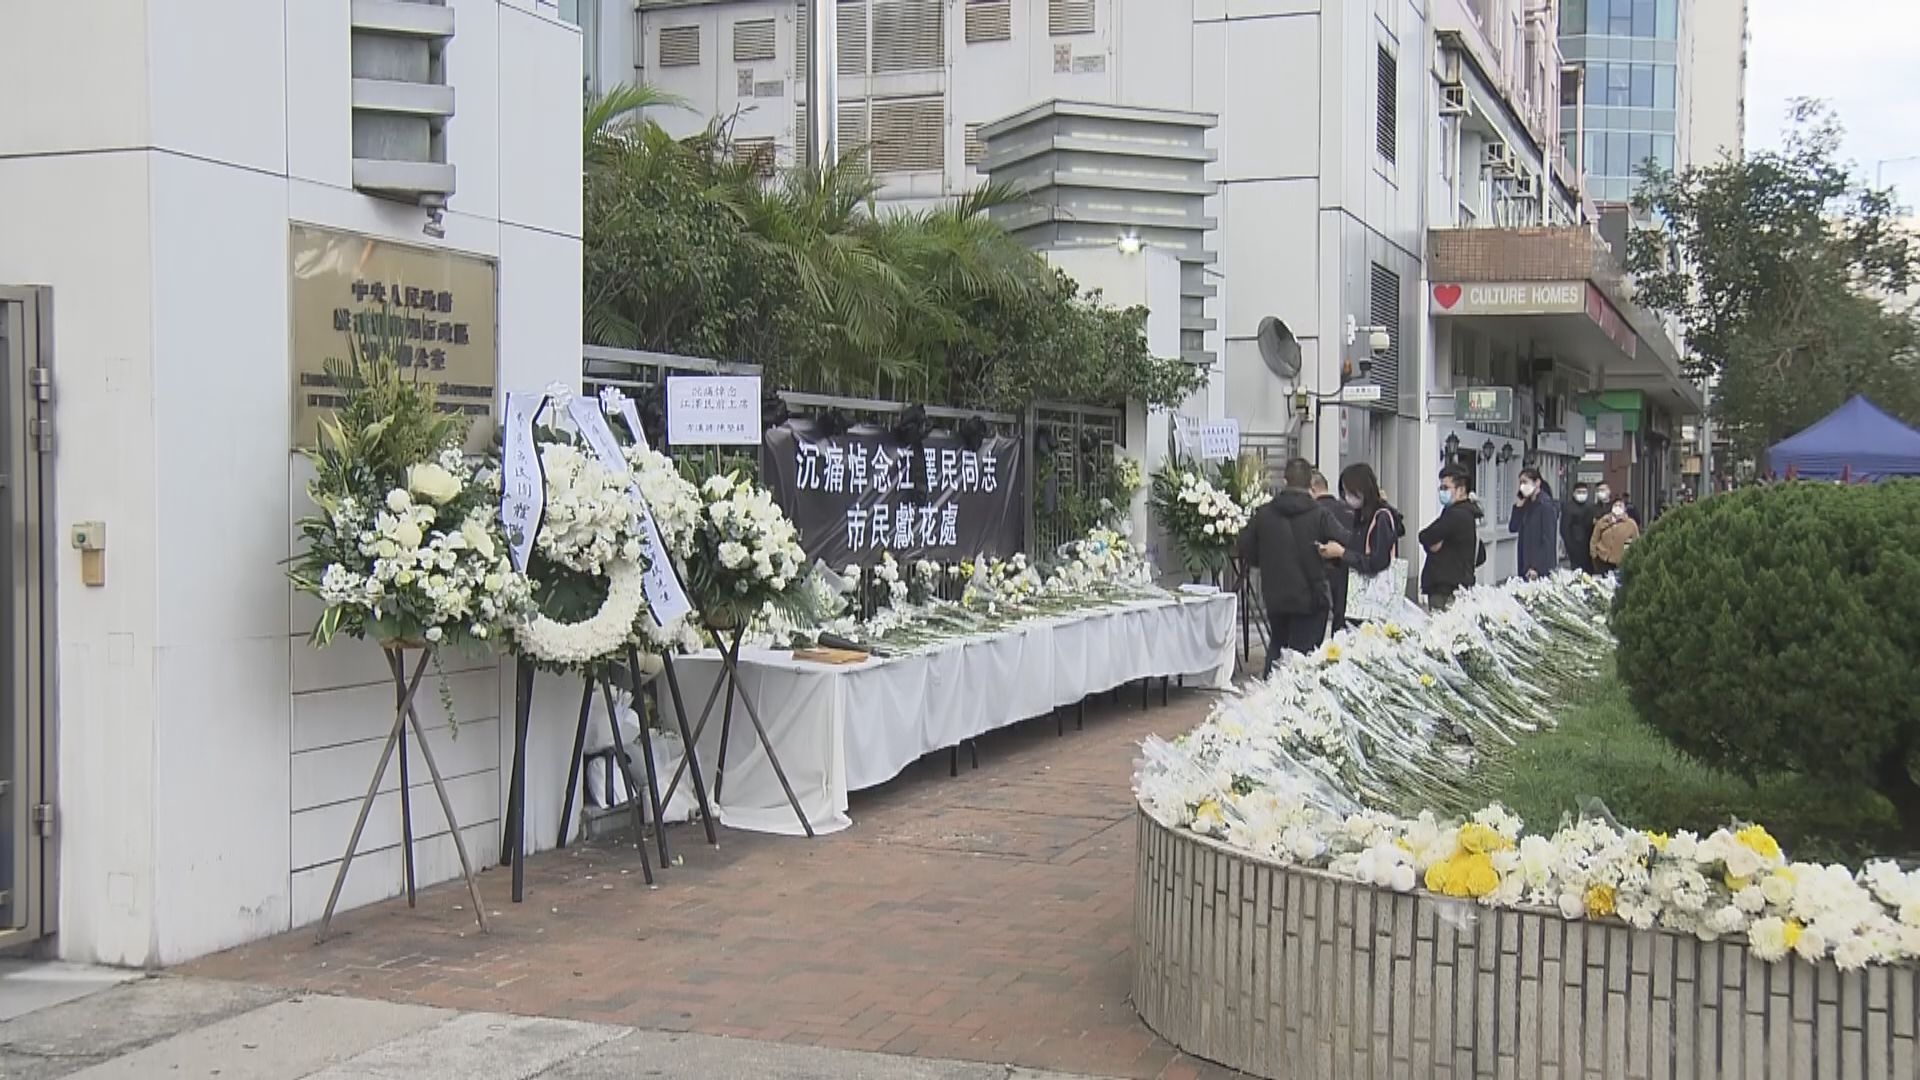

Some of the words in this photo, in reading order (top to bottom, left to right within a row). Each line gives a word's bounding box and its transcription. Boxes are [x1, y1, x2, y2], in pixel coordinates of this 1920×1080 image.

[352, 279, 452, 313] 中央人民政府
[1470, 287, 1526, 305] CULTURE
[1532, 286, 1578, 304] HOMES
[333, 308, 470, 345] 駐香別行政區
[361, 342, 446, 371] 辦公室
[796, 441, 998, 494] 沉痛悼念江澤民同志
[847, 501, 959, 552] 市民獻花處
